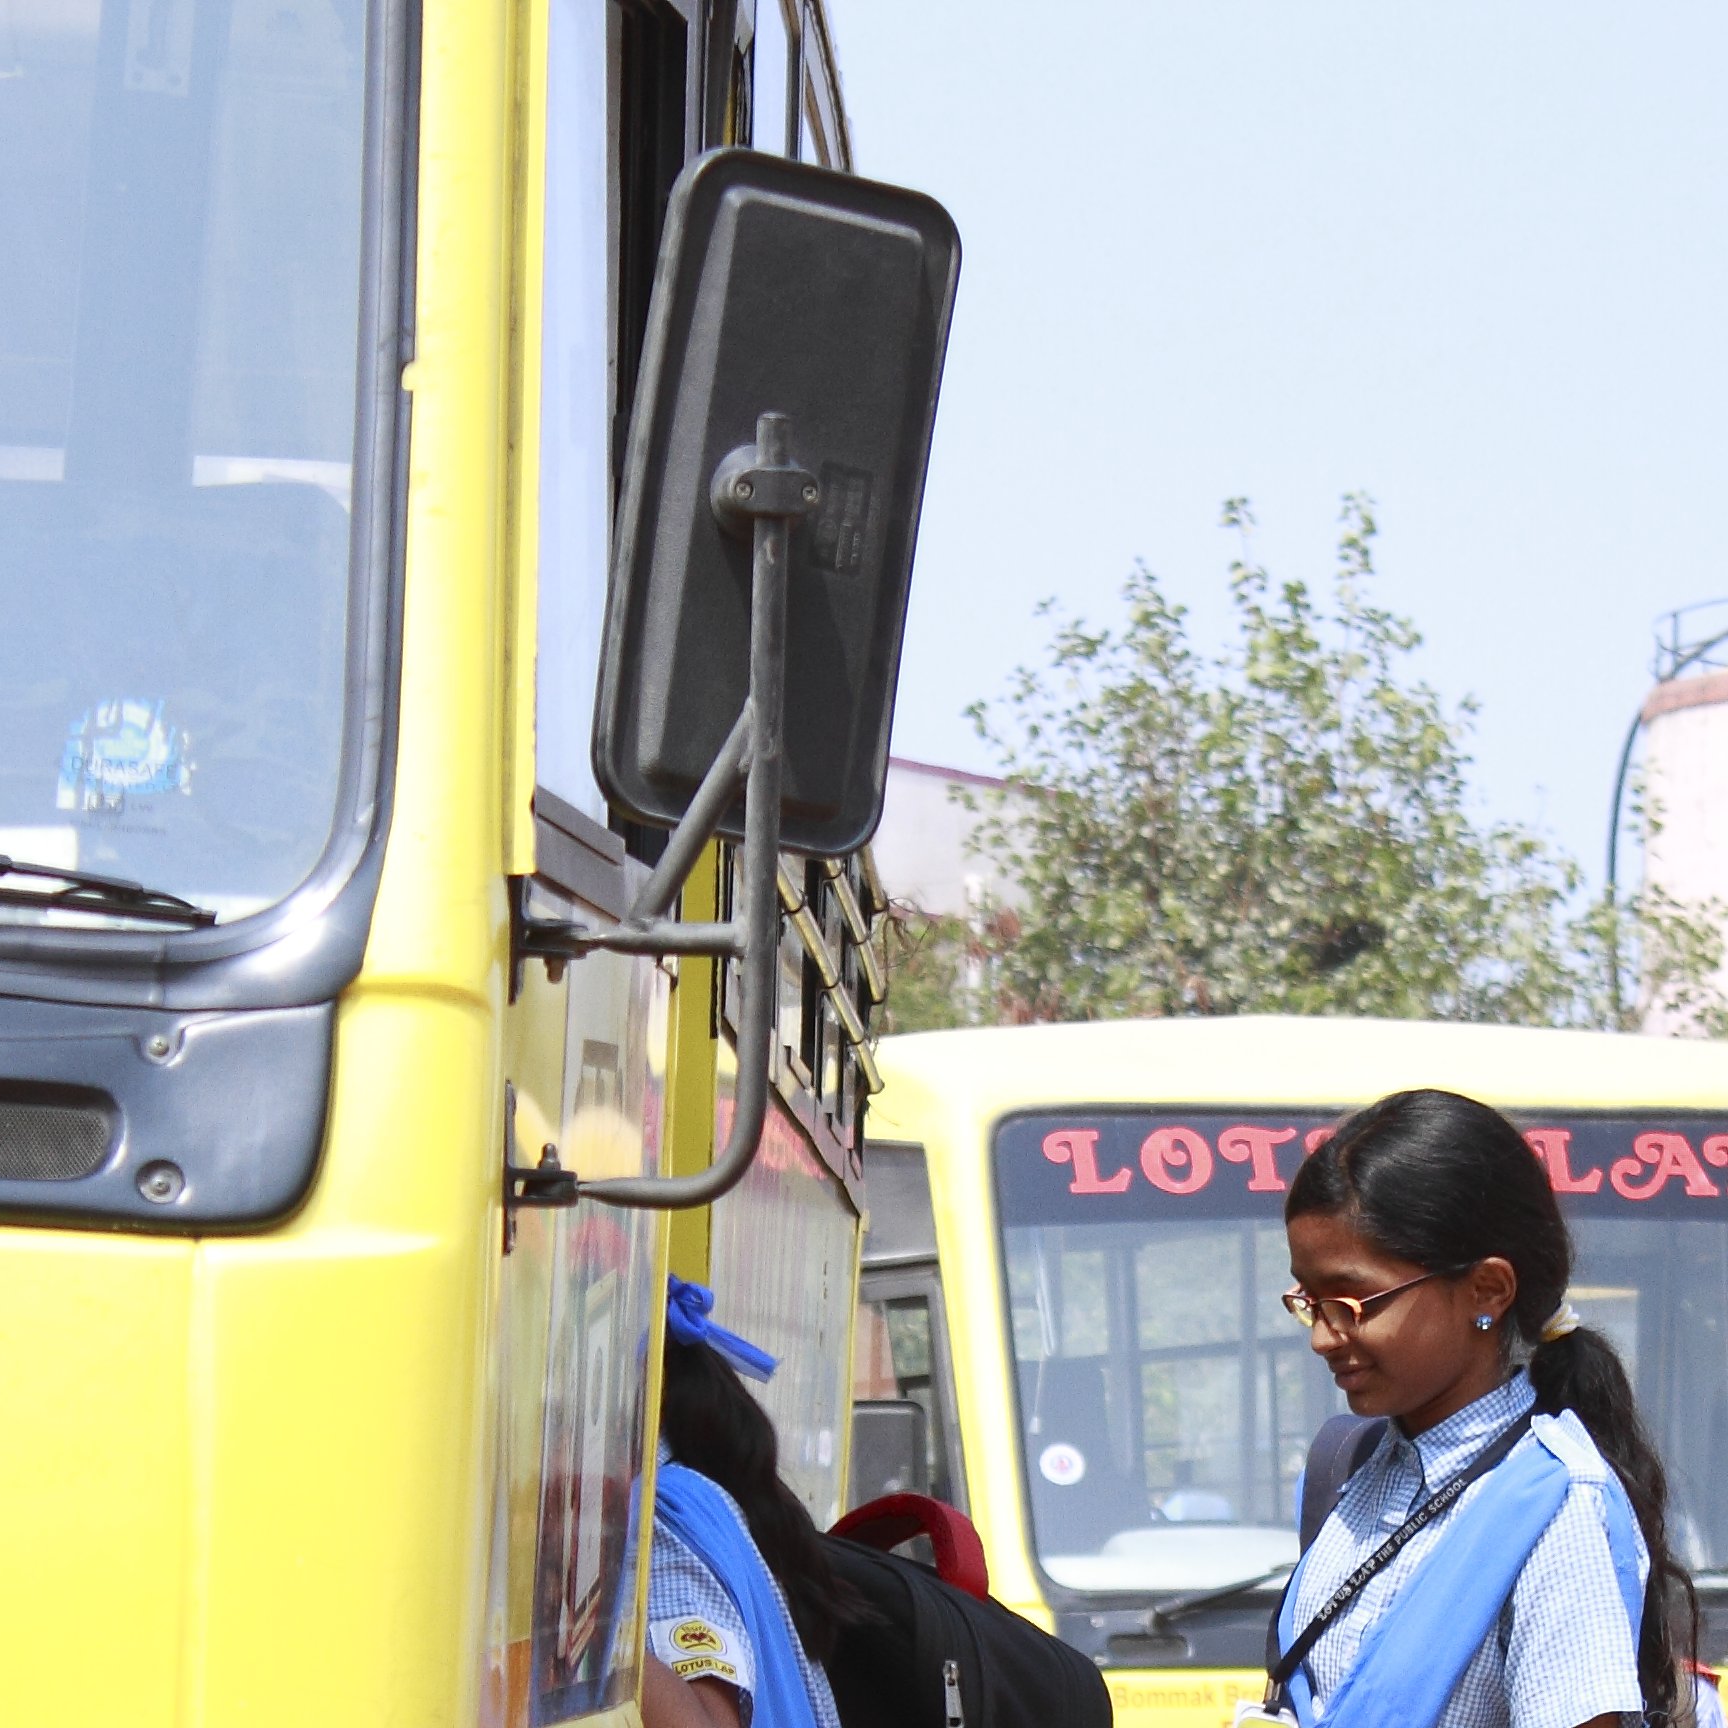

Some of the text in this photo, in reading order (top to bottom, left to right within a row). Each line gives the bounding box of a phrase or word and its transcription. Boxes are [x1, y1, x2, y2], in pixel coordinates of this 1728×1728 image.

[1041, 1124, 1340, 1197] LOT
[1317, 1477, 1468, 1621] LOTUS LAP THE PUBLIC SCHOOL
[675, 1659, 712, 1675] LOTUS
